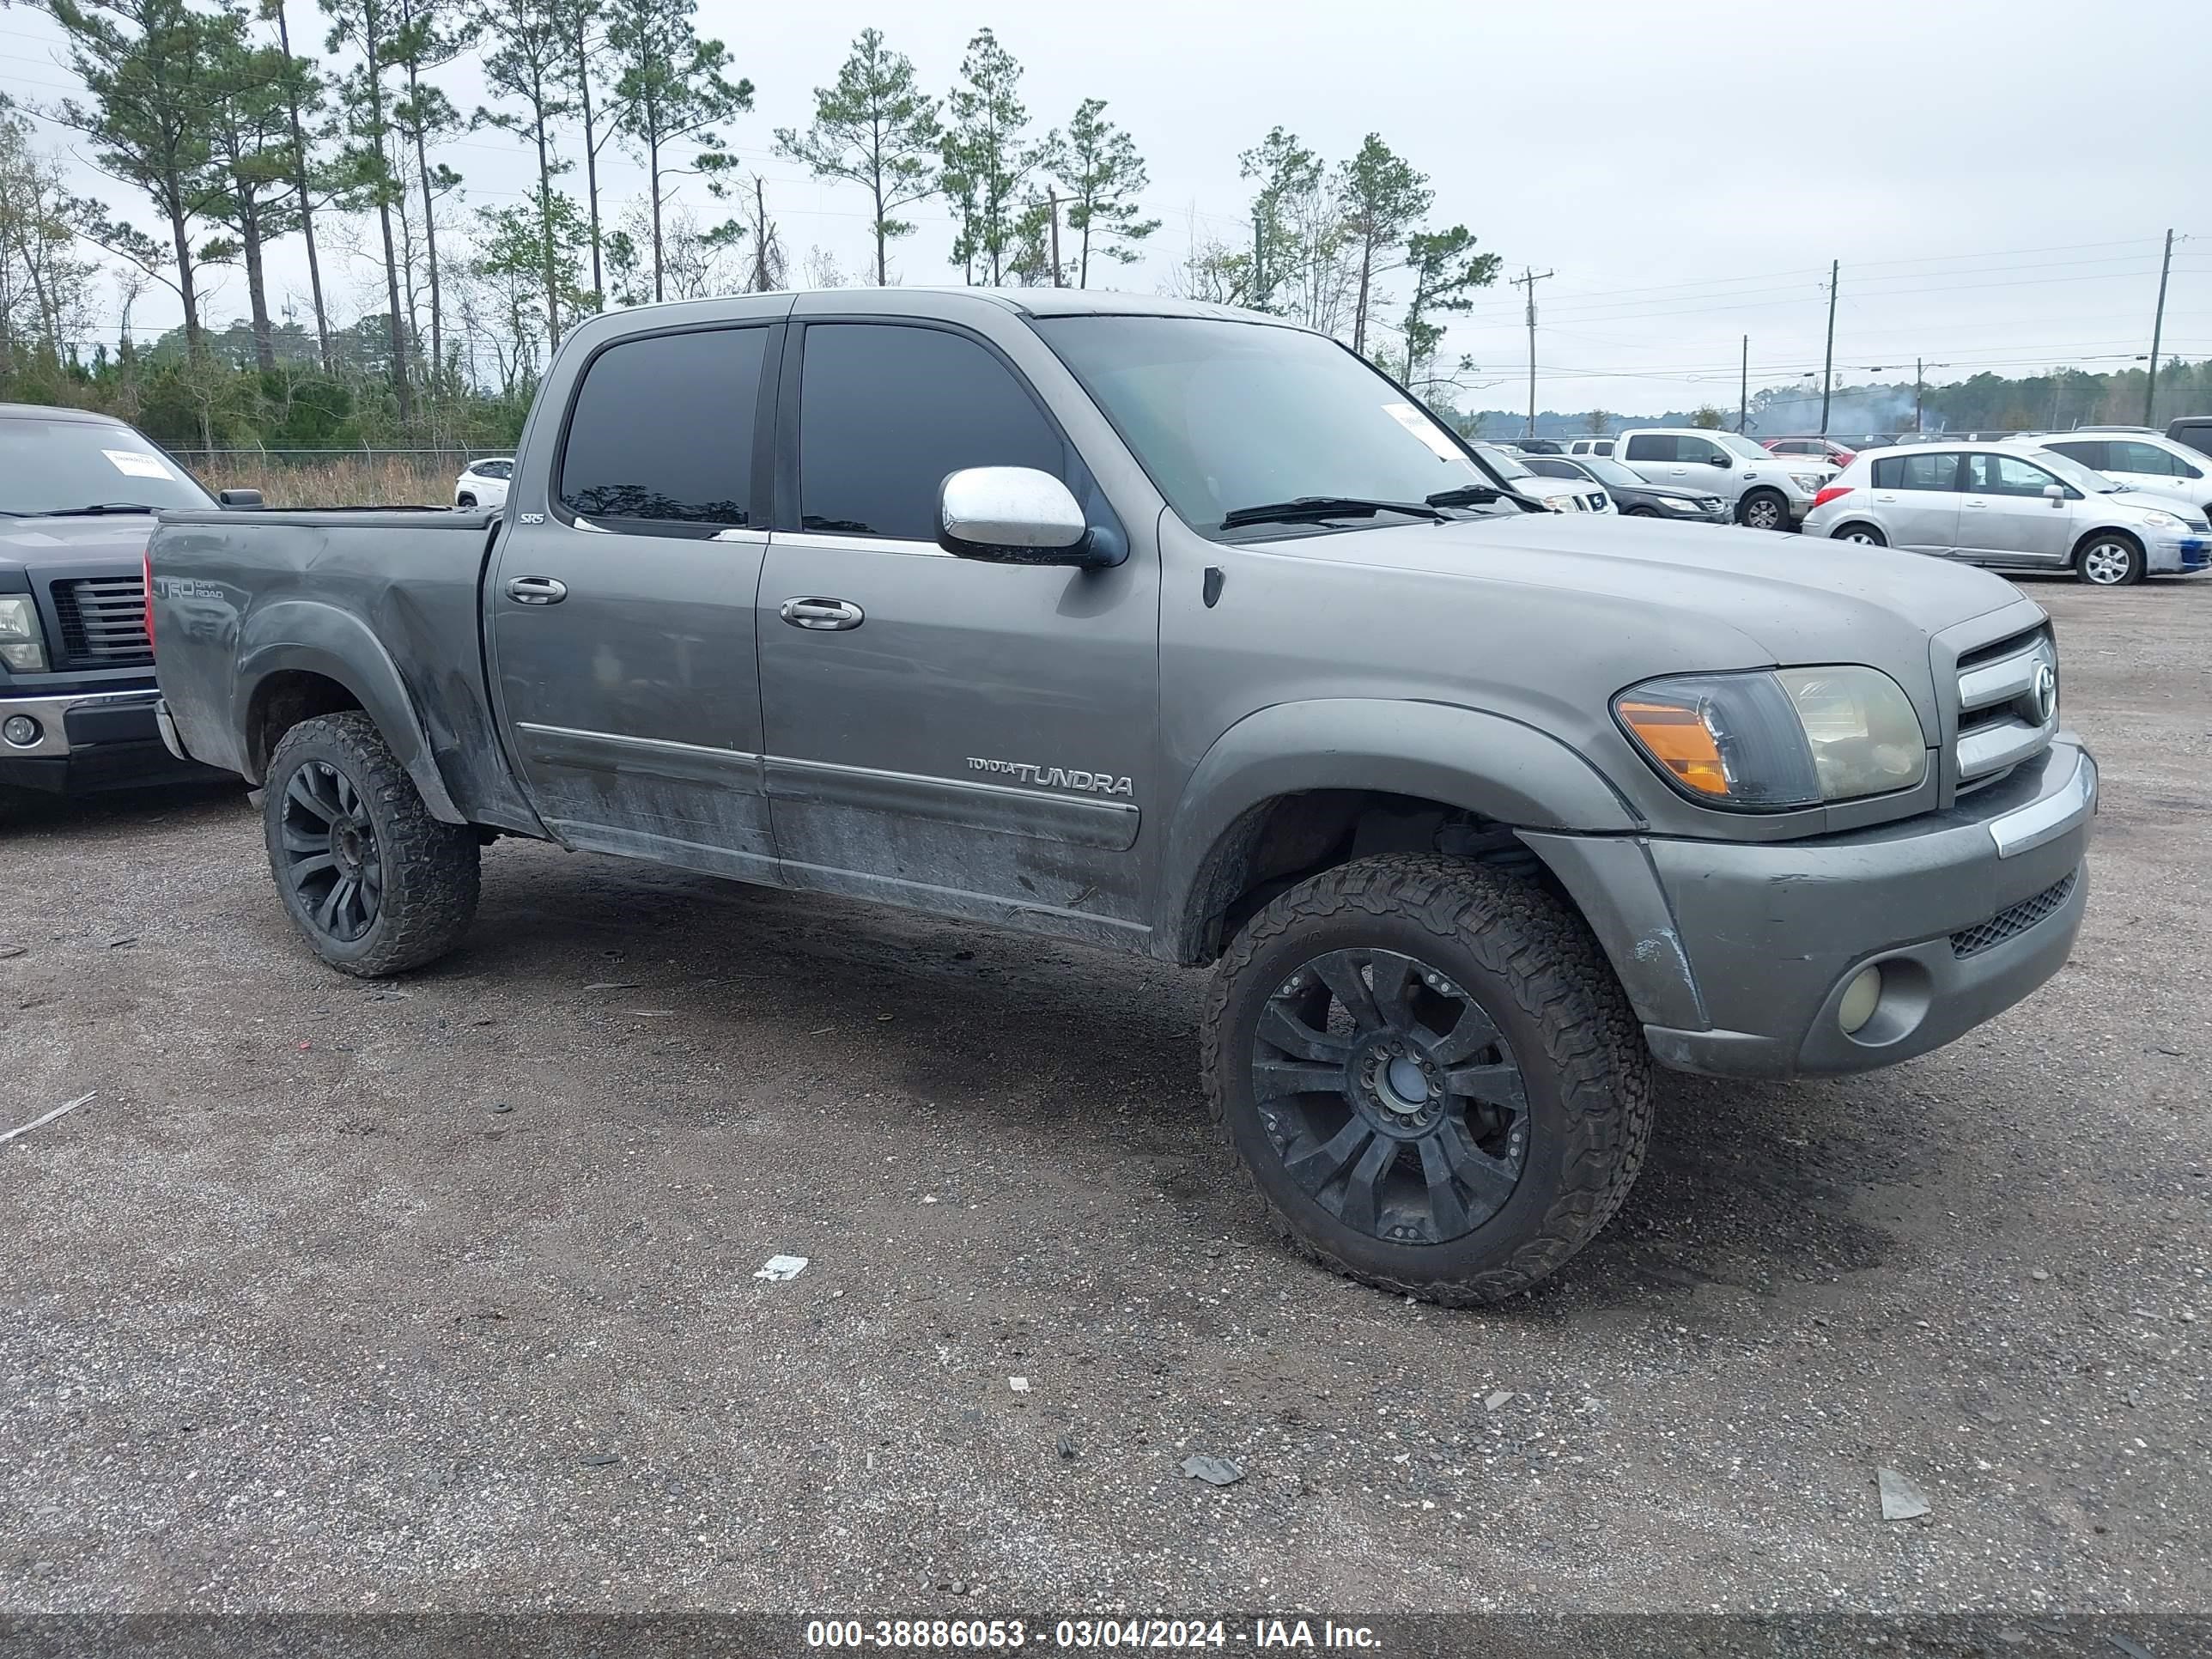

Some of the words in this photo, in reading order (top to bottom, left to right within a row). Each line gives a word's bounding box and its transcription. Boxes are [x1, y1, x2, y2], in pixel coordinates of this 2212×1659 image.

[520, 513, 544, 525] SR5
[156, 577, 195, 599] TRD
[195, 589, 224, 599] ROAD
[966, 757, 1017, 775] TOYOTA
[1012, 763, 1134, 797] TUNDRA
